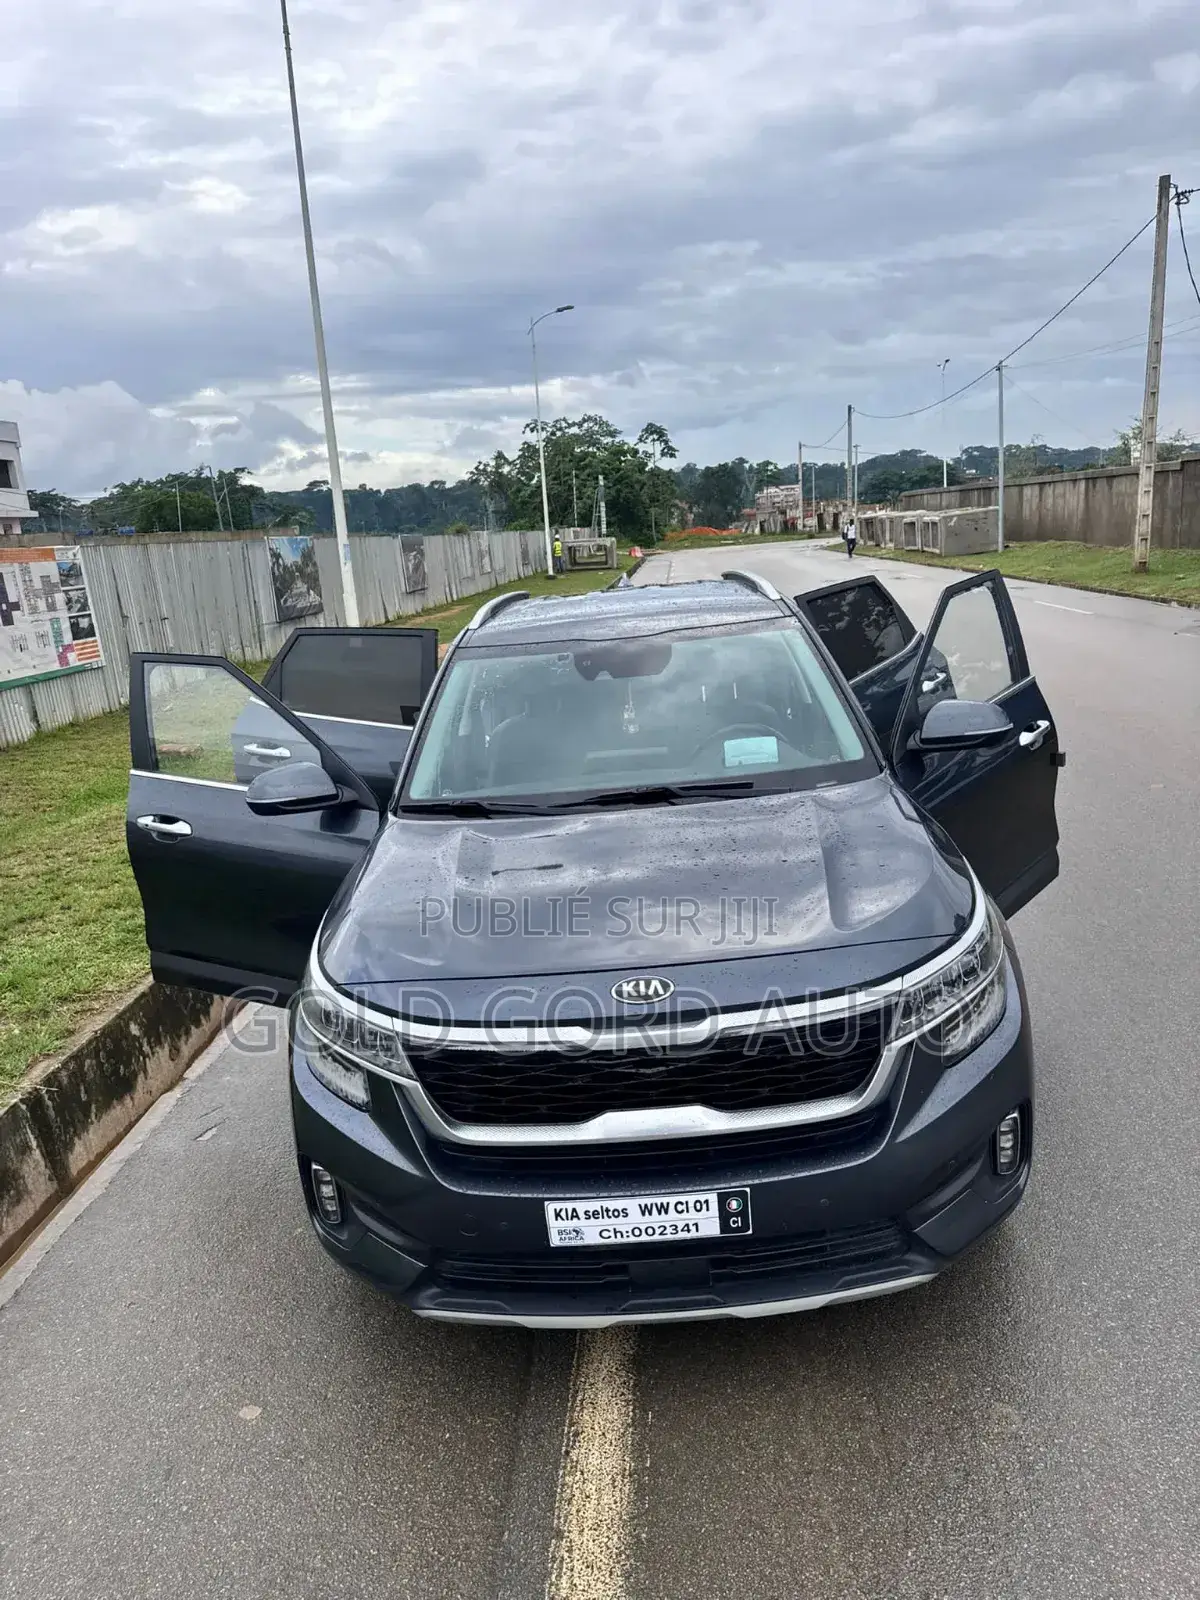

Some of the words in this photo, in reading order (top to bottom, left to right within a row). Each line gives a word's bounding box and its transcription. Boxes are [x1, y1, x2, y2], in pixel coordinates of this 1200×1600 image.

[622, 979, 664, 998] KIA
[554, 1207, 581, 1221] KIA
[584, 1205, 629, 1220] seltos
[638, 1202, 670, 1217] WW
[674, 1200, 690, 1214] CI
[693, 1199, 710, 1213] 01
[598, 1222, 701, 1240] Ch:002341
[729, 1216, 742, 1228] CI
